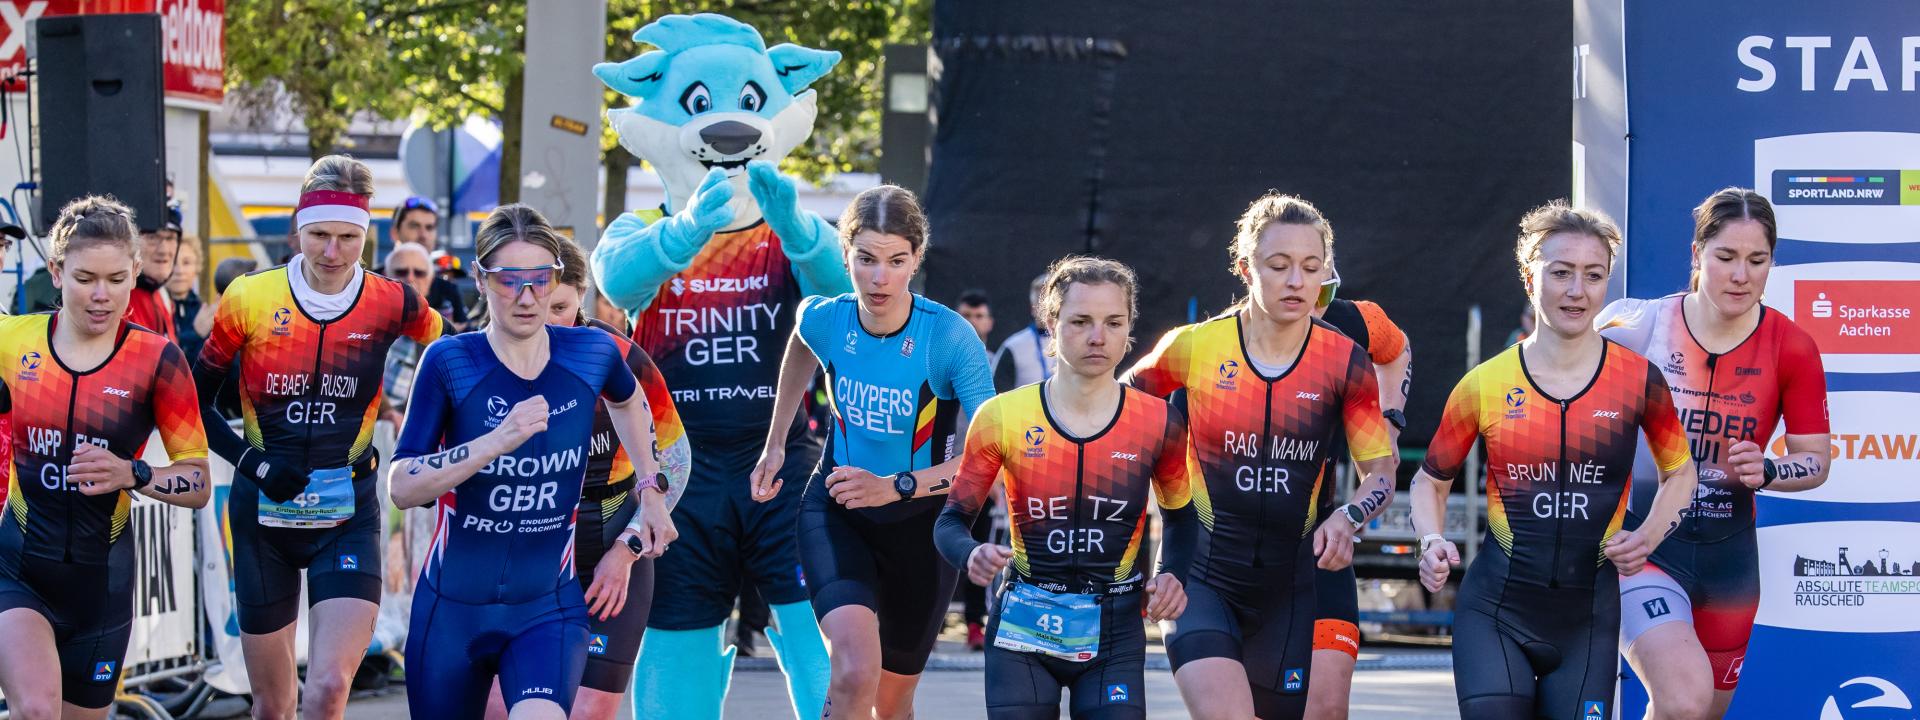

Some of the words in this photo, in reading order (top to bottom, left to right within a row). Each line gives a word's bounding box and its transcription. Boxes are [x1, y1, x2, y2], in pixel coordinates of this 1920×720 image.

[1788, 188, 1885, 199] SPORTLAND.NRW
[690, 274, 769, 293] SUZUKI
[659, 303, 782, 336] TRINITY
[1839, 305, 1911, 321] Sparkasse
[1839, 323, 1891, 336] Aachen
[685, 336, 761, 366] GER
[266, 373, 280, 395] DE
[321, 374, 359, 398] RUSZIN
[672, 389, 700, 403] TRI
[704, 385, 776, 400] TRAVEL
[837, 376, 913, 417] CUYPERS
[286, 401, 337, 424] GER
[846, 405, 904, 434] BEL
[1674, 407, 1758, 440] IEDER
[478, 446, 582, 477] BROWN
[1235, 465, 1291, 494] GER
[293, 492, 320, 508] 49
[488, 481, 558, 512] GBR
[1533, 491, 1589, 520] GER
[518, 523, 562, 533] COACHING
[520, 514, 567, 525] ENDURANCE
[1047, 528, 1105, 554] GER
[1037, 581, 1067, 593] sailfish
[1108, 584, 1134, 595] sailfish
[1796, 580, 1863, 593] ABSOLUTE
[1795, 594, 1865, 607] RAUSCHEID
[1036, 613, 1063, 635] 43
[522, 687, 553, 696] HUUB
